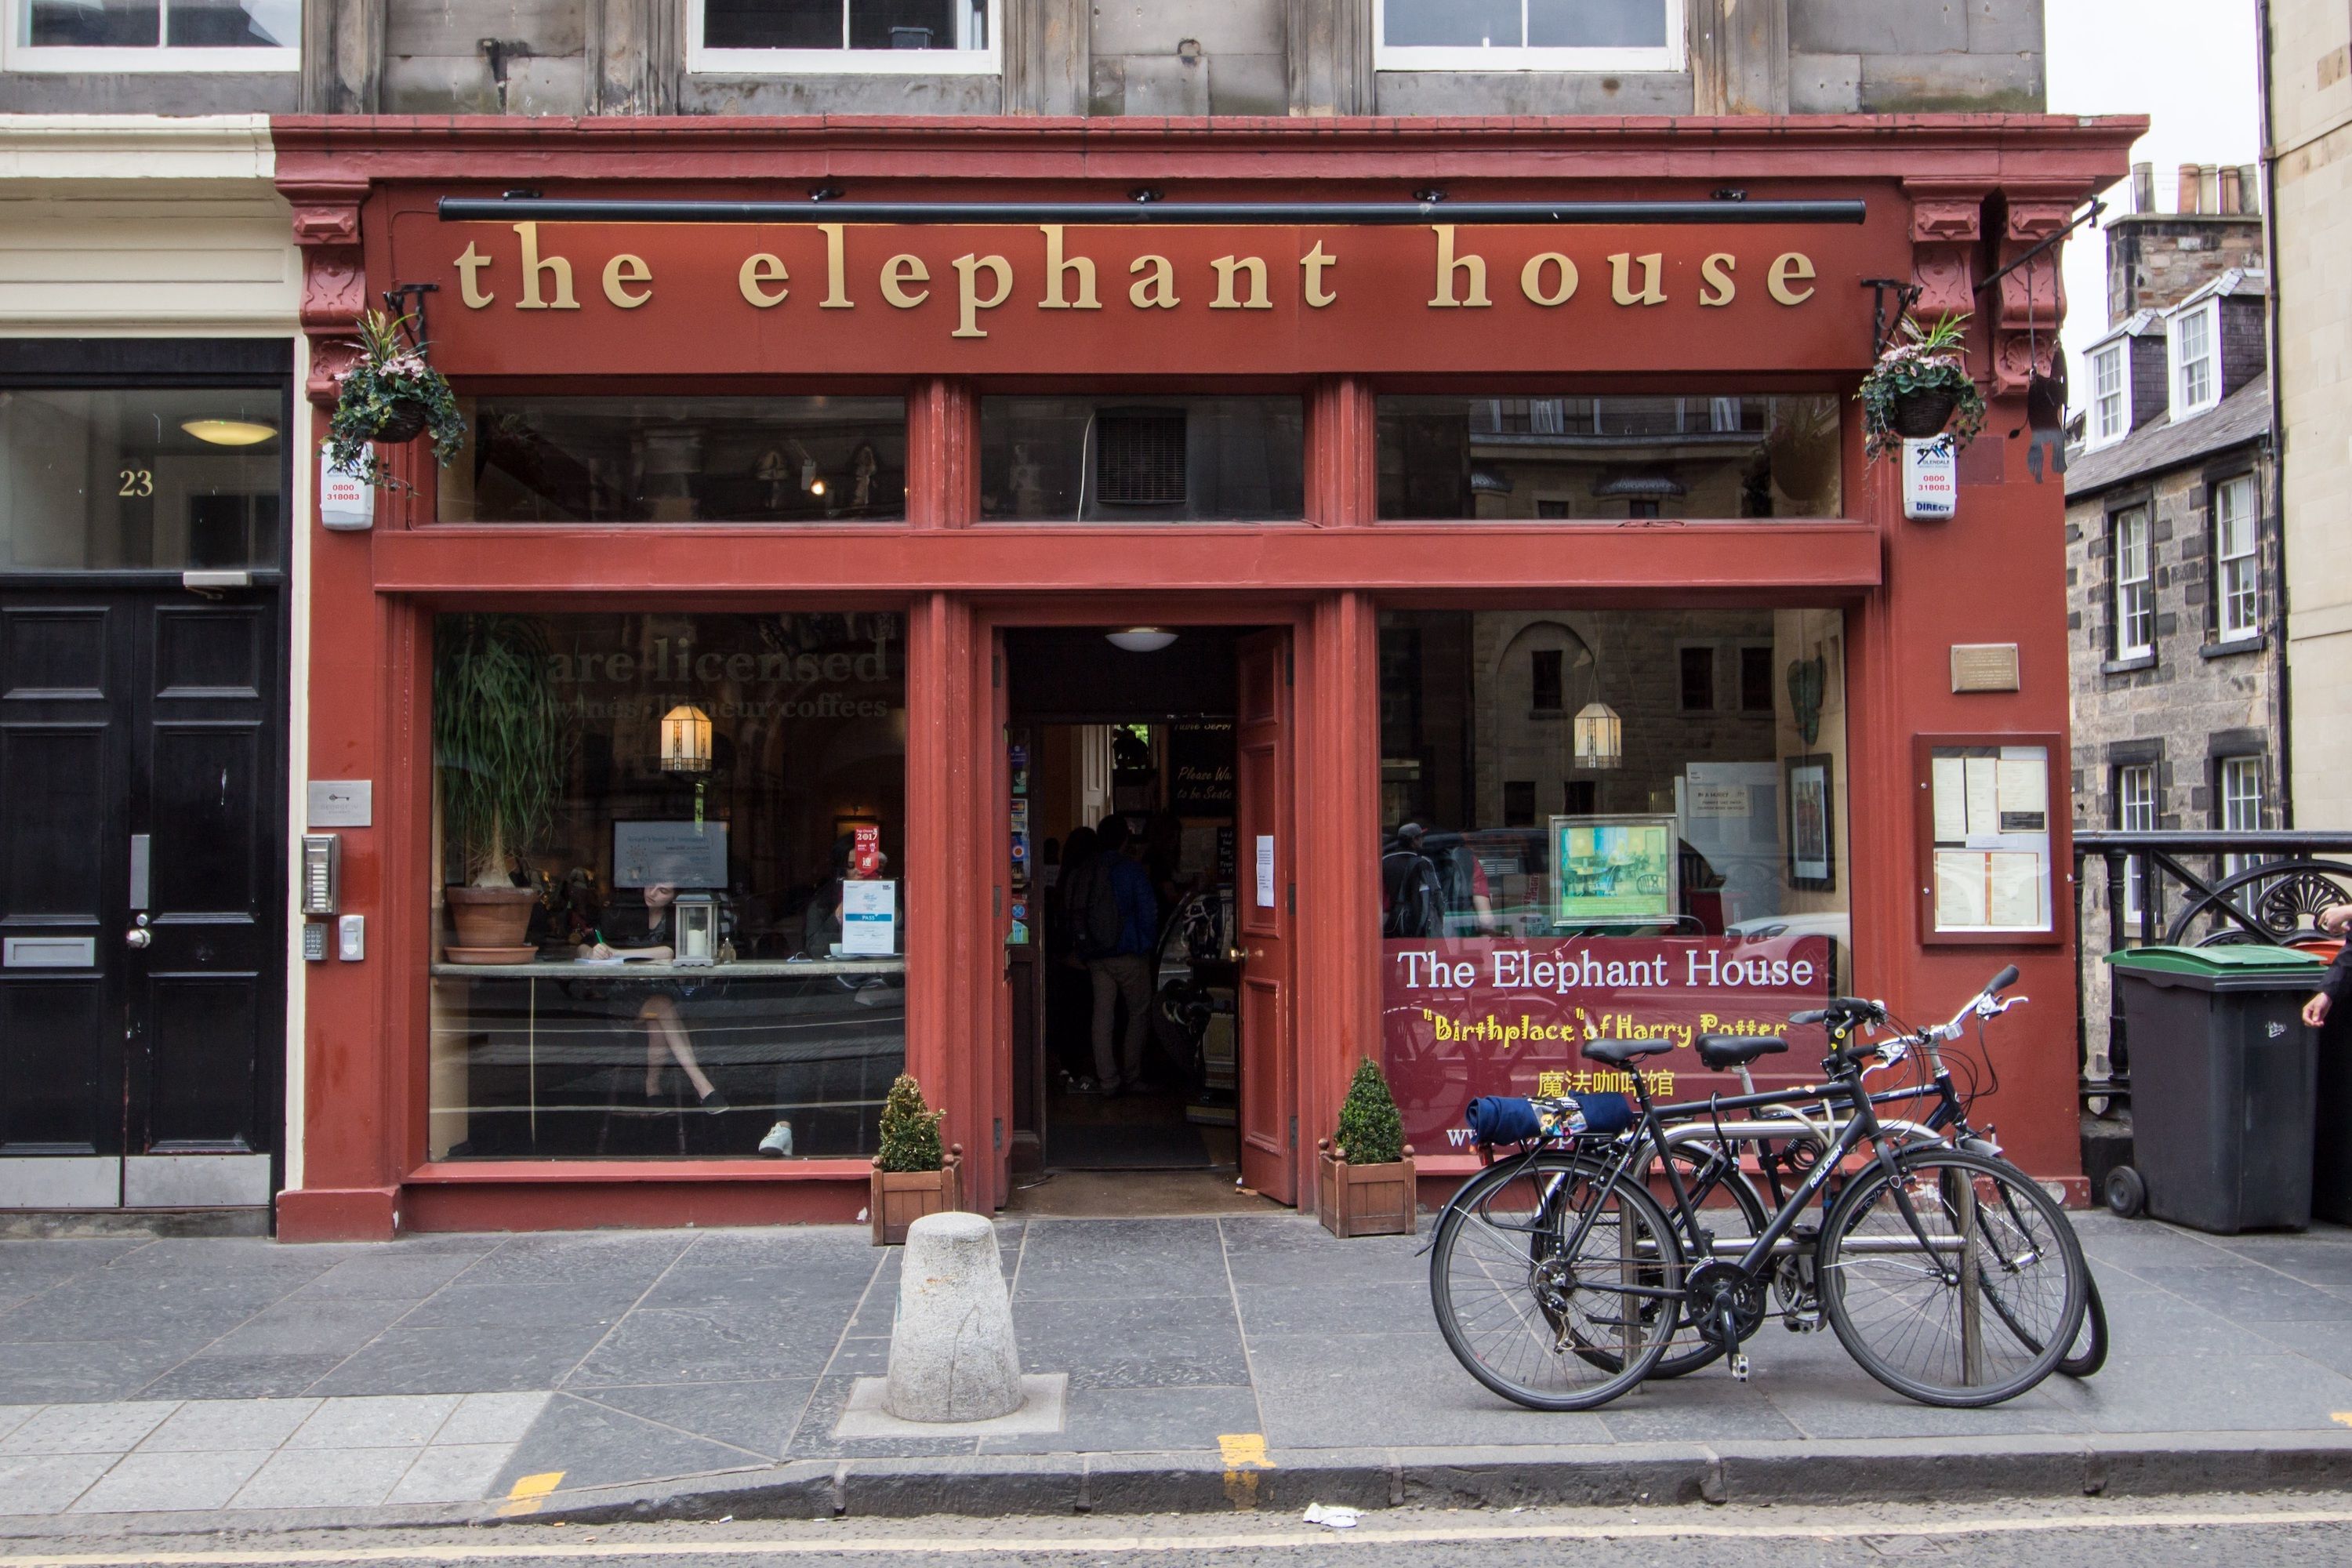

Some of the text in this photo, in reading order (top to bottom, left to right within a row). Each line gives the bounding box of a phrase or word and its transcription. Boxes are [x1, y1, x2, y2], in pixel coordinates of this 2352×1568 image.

[453, 222, 1817, 337] the elephant house
[118, 470, 153, 497] 23
[1916, 502, 1950, 511] DIRECT
[653, 636, 890, 684] licensed
[785, 691, 888, 719] coffees
[1178, 766, 1212, 780] Please
[1203, 785, 1232, 800] Seate
[856, 832, 878, 841] 2017
[1397, 949, 1813, 994] The Elephant House
[1582, 1014, 1612, 1040] of
[1616, 1014, 1692, 1048] Harry
[1809, 1145, 1842, 1189] RALEIGH
